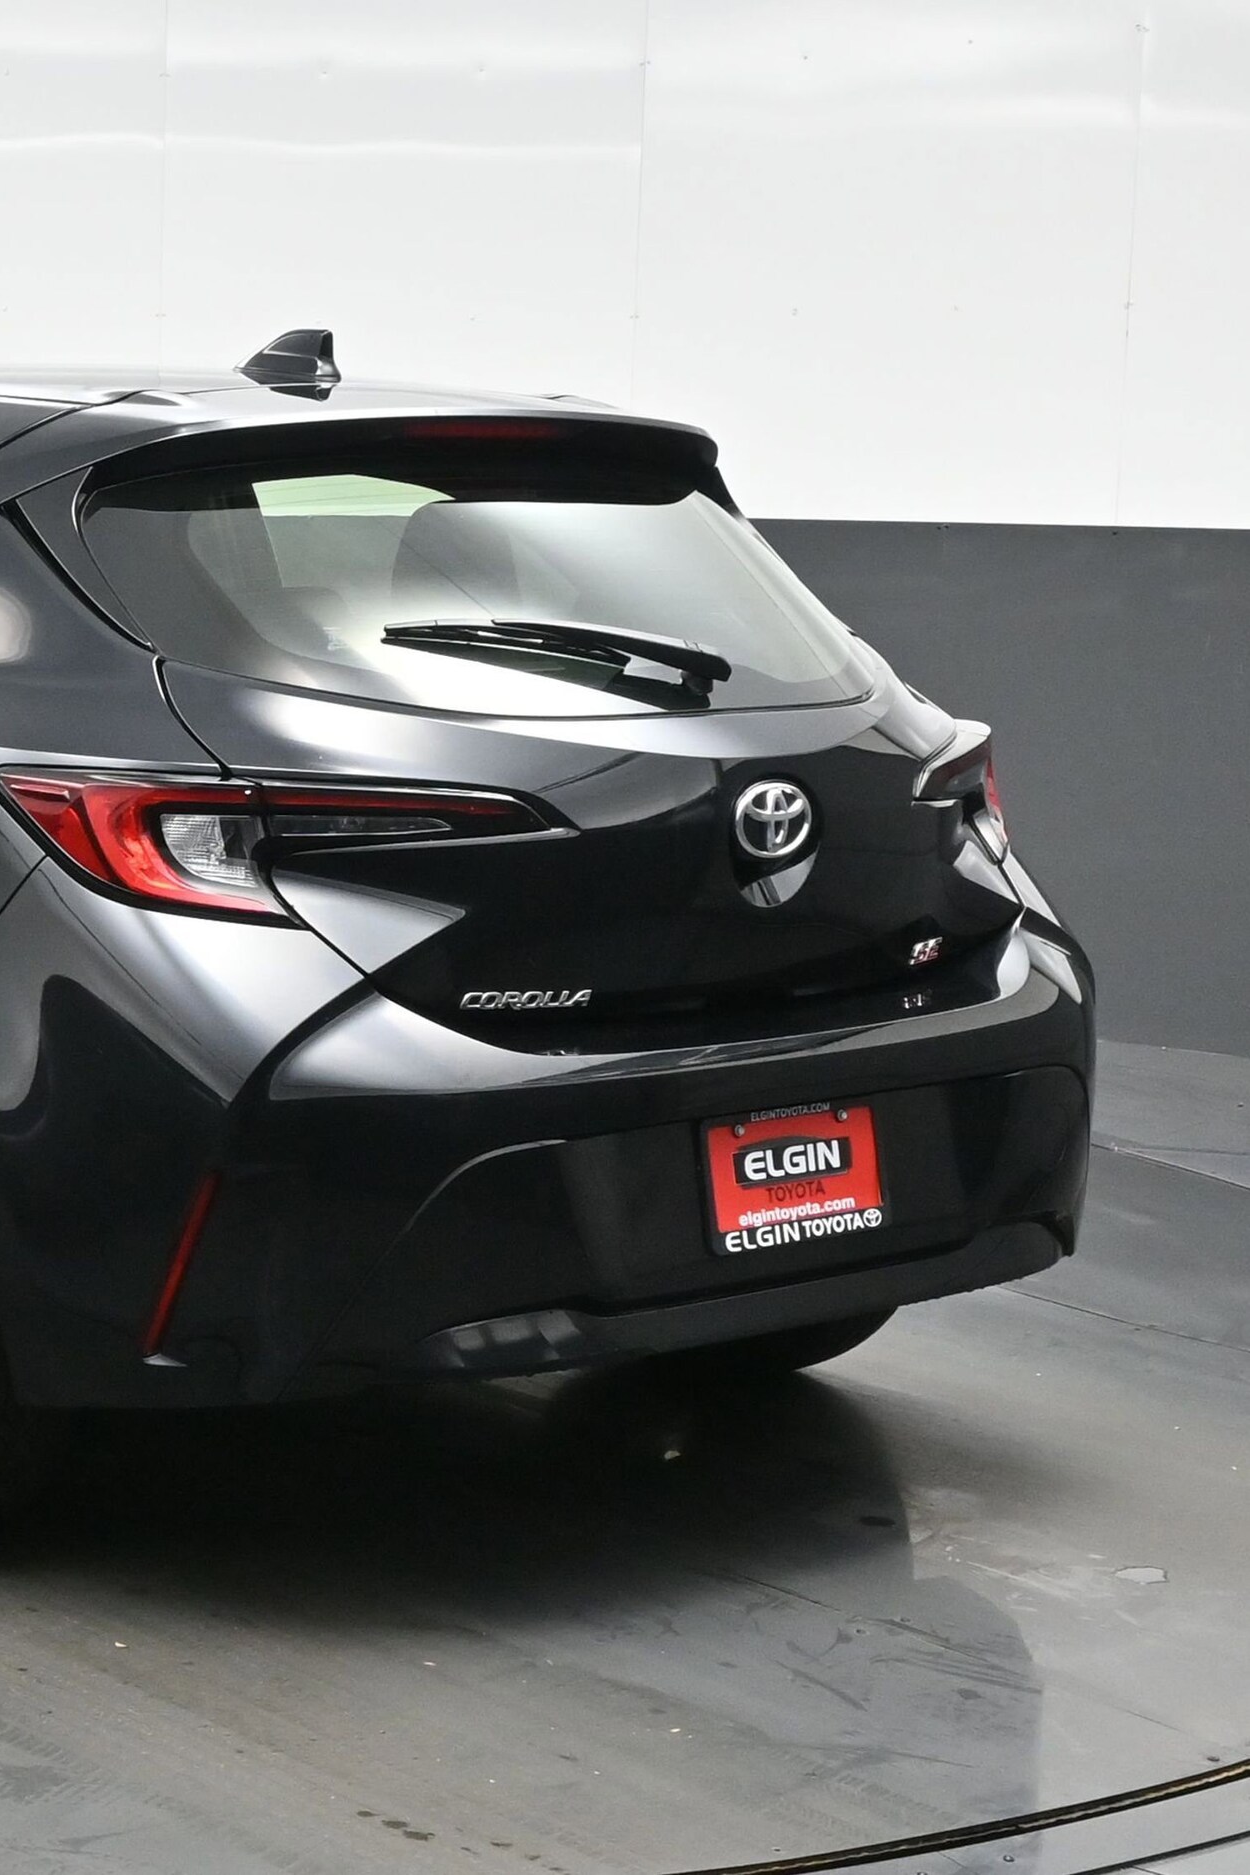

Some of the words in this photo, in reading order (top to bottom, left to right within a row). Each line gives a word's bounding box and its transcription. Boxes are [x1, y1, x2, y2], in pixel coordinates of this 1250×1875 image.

[460, 989, 592, 1010] COROLLA
[750, 1103, 830, 1121] ELGINTOYOTA.COM
[744, 1140, 841, 1180] ELGIN
[766, 1180, 825, 1202] TOYOTA
[739, 1197, 855, 1226] elgintoyota.com
[725, 1223, 800, 1252] ELGIN
[802, 1213, 864, 1238] TOYOTA
